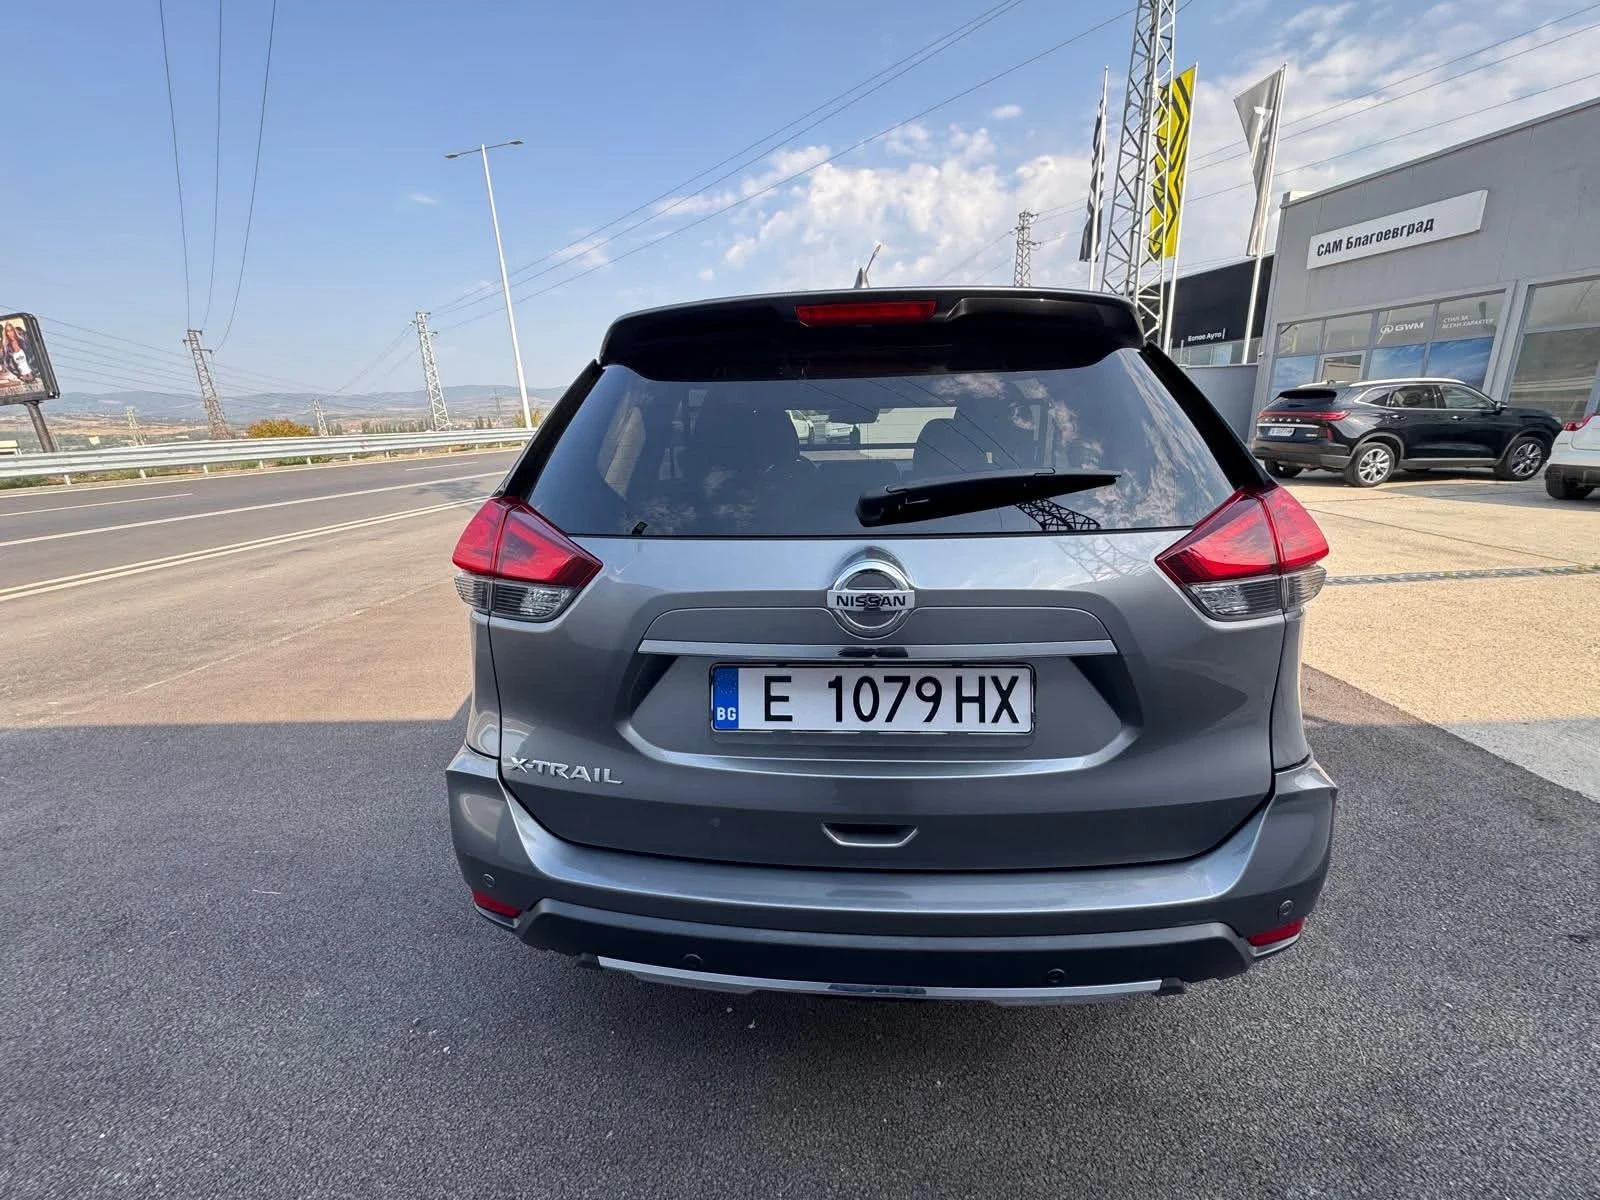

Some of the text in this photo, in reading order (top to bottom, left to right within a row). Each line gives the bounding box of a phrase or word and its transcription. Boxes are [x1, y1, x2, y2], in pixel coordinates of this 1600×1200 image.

[1316, 218, 1435, 257] САМ Благоевград
[1394, 322, 1425, 332] GWM
[835, 595, 906, 608] NISSAN
[763, 675, 793, 722] E
[716, 706, 737, 721] BG
[510, 756, 624, 785] X-TRAIL
